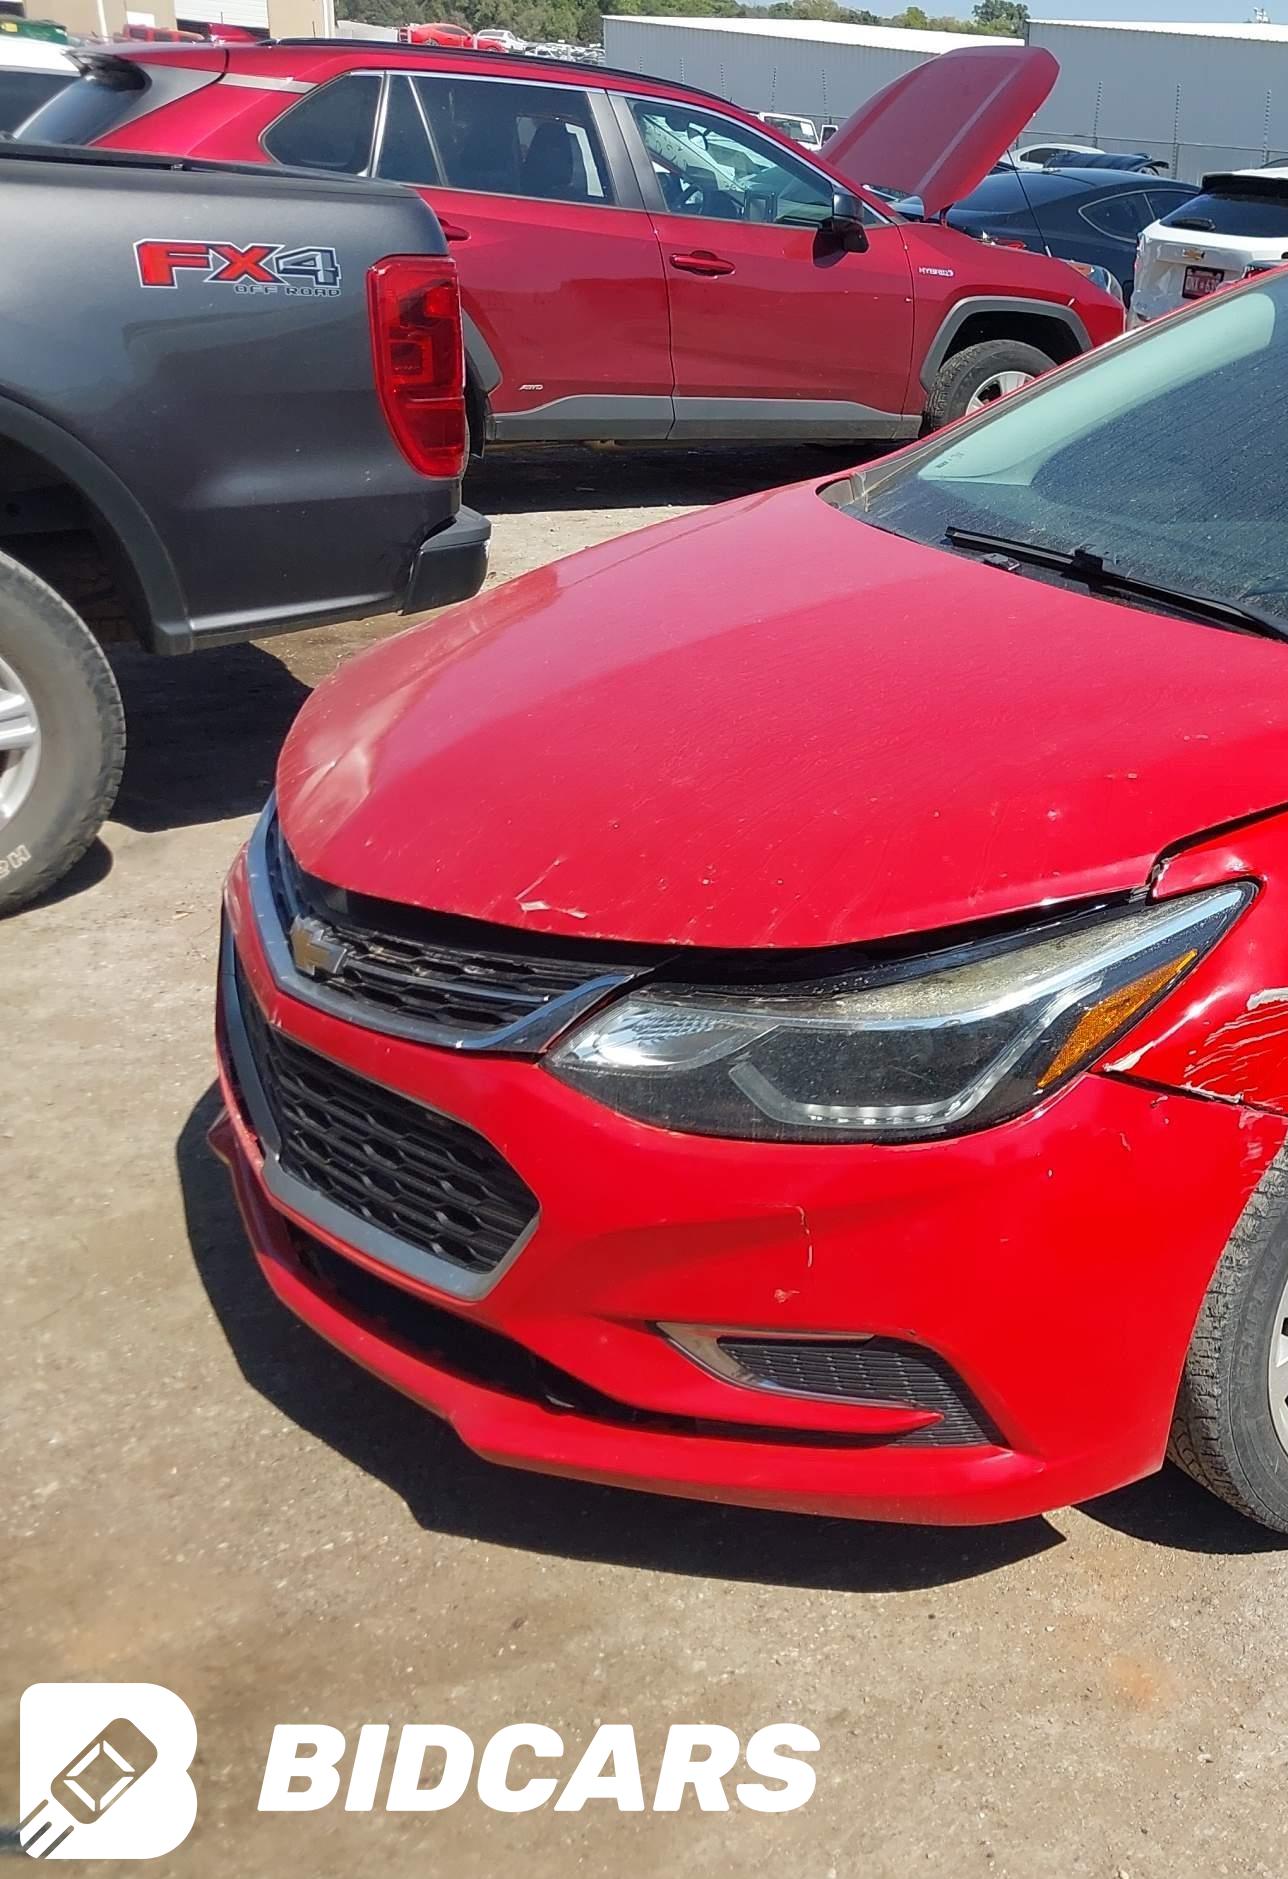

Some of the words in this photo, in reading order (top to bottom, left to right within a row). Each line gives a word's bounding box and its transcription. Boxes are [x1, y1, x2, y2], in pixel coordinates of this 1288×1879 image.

[133, 238, 341, 288] FX4
[234, 284, 277, 294] OFF
[285, 287, 341, 297] ROAD
